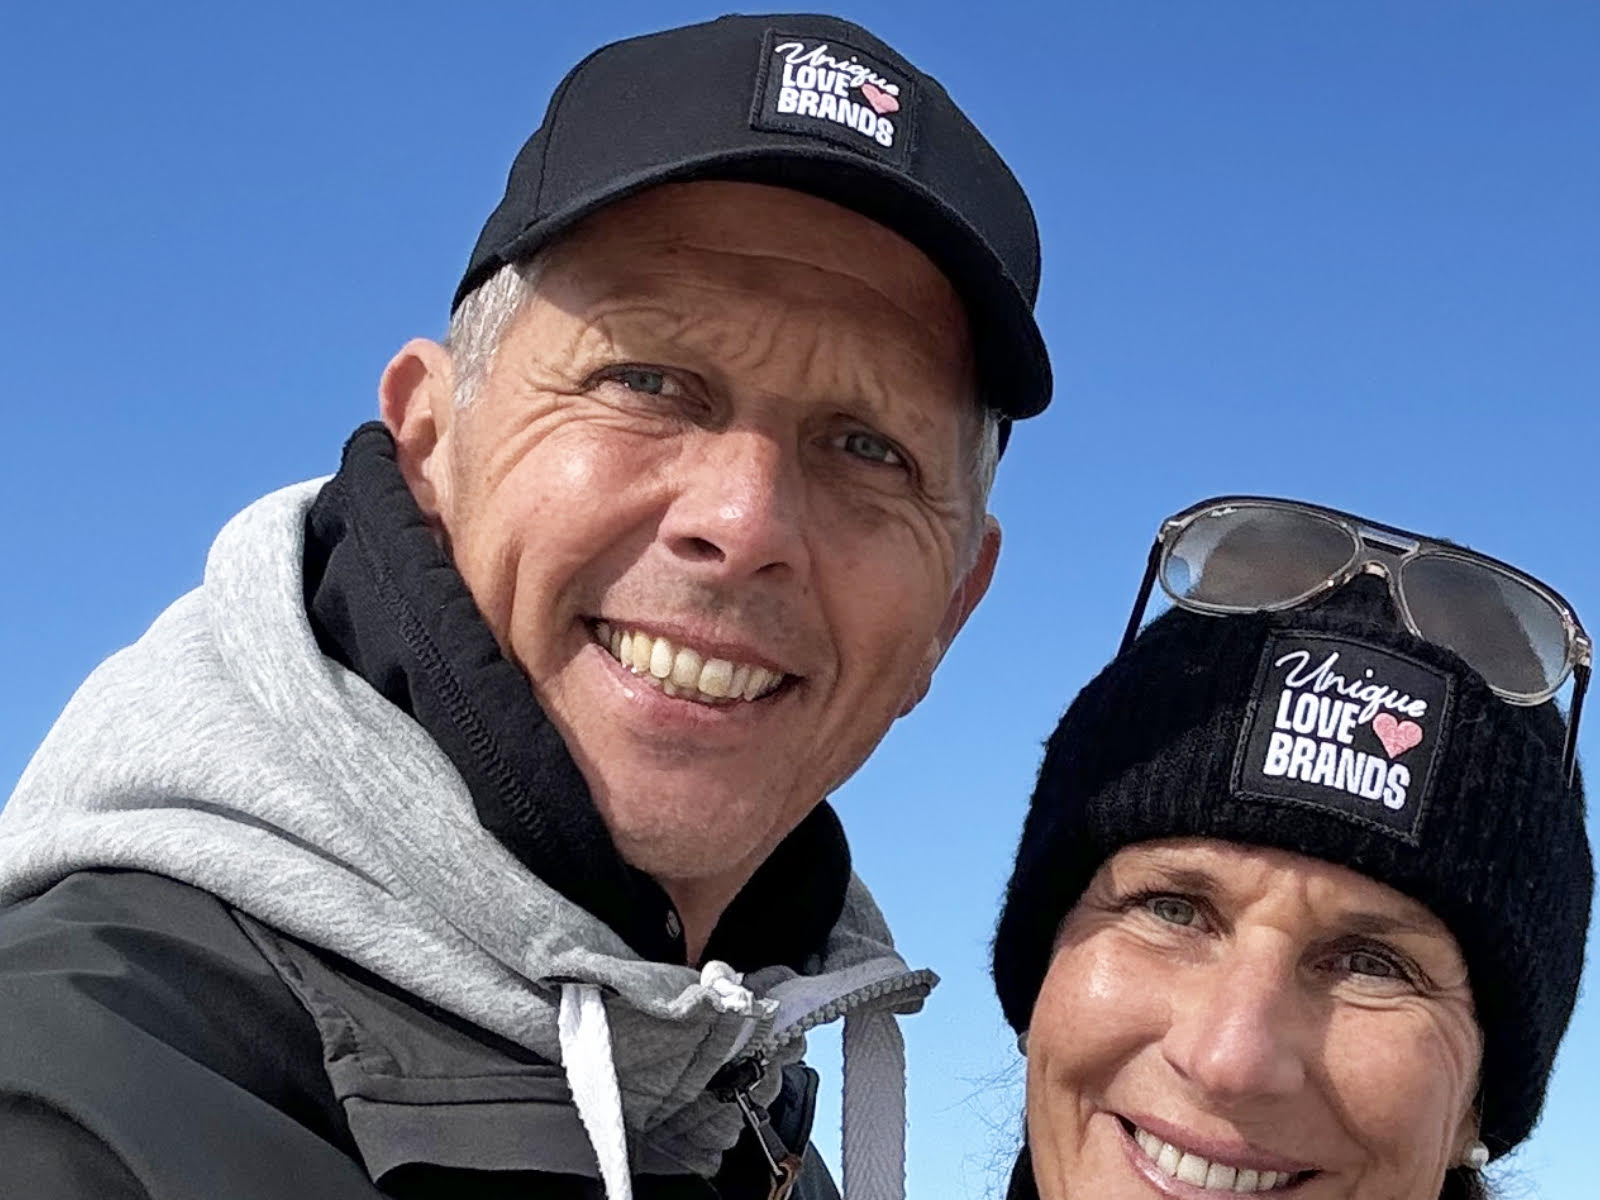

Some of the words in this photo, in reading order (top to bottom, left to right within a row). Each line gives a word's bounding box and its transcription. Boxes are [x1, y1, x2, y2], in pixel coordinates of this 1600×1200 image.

[775, 42, 899, 96] Unique
[782, 63, 849, 98] LOVE
[777, 88, 894, 147] BRANDS
[1275, 650, 1427, 724] Unique
[1275, 689, 1361, 744] LOVE
[1263, 731, 1410, 810] BRANDS
